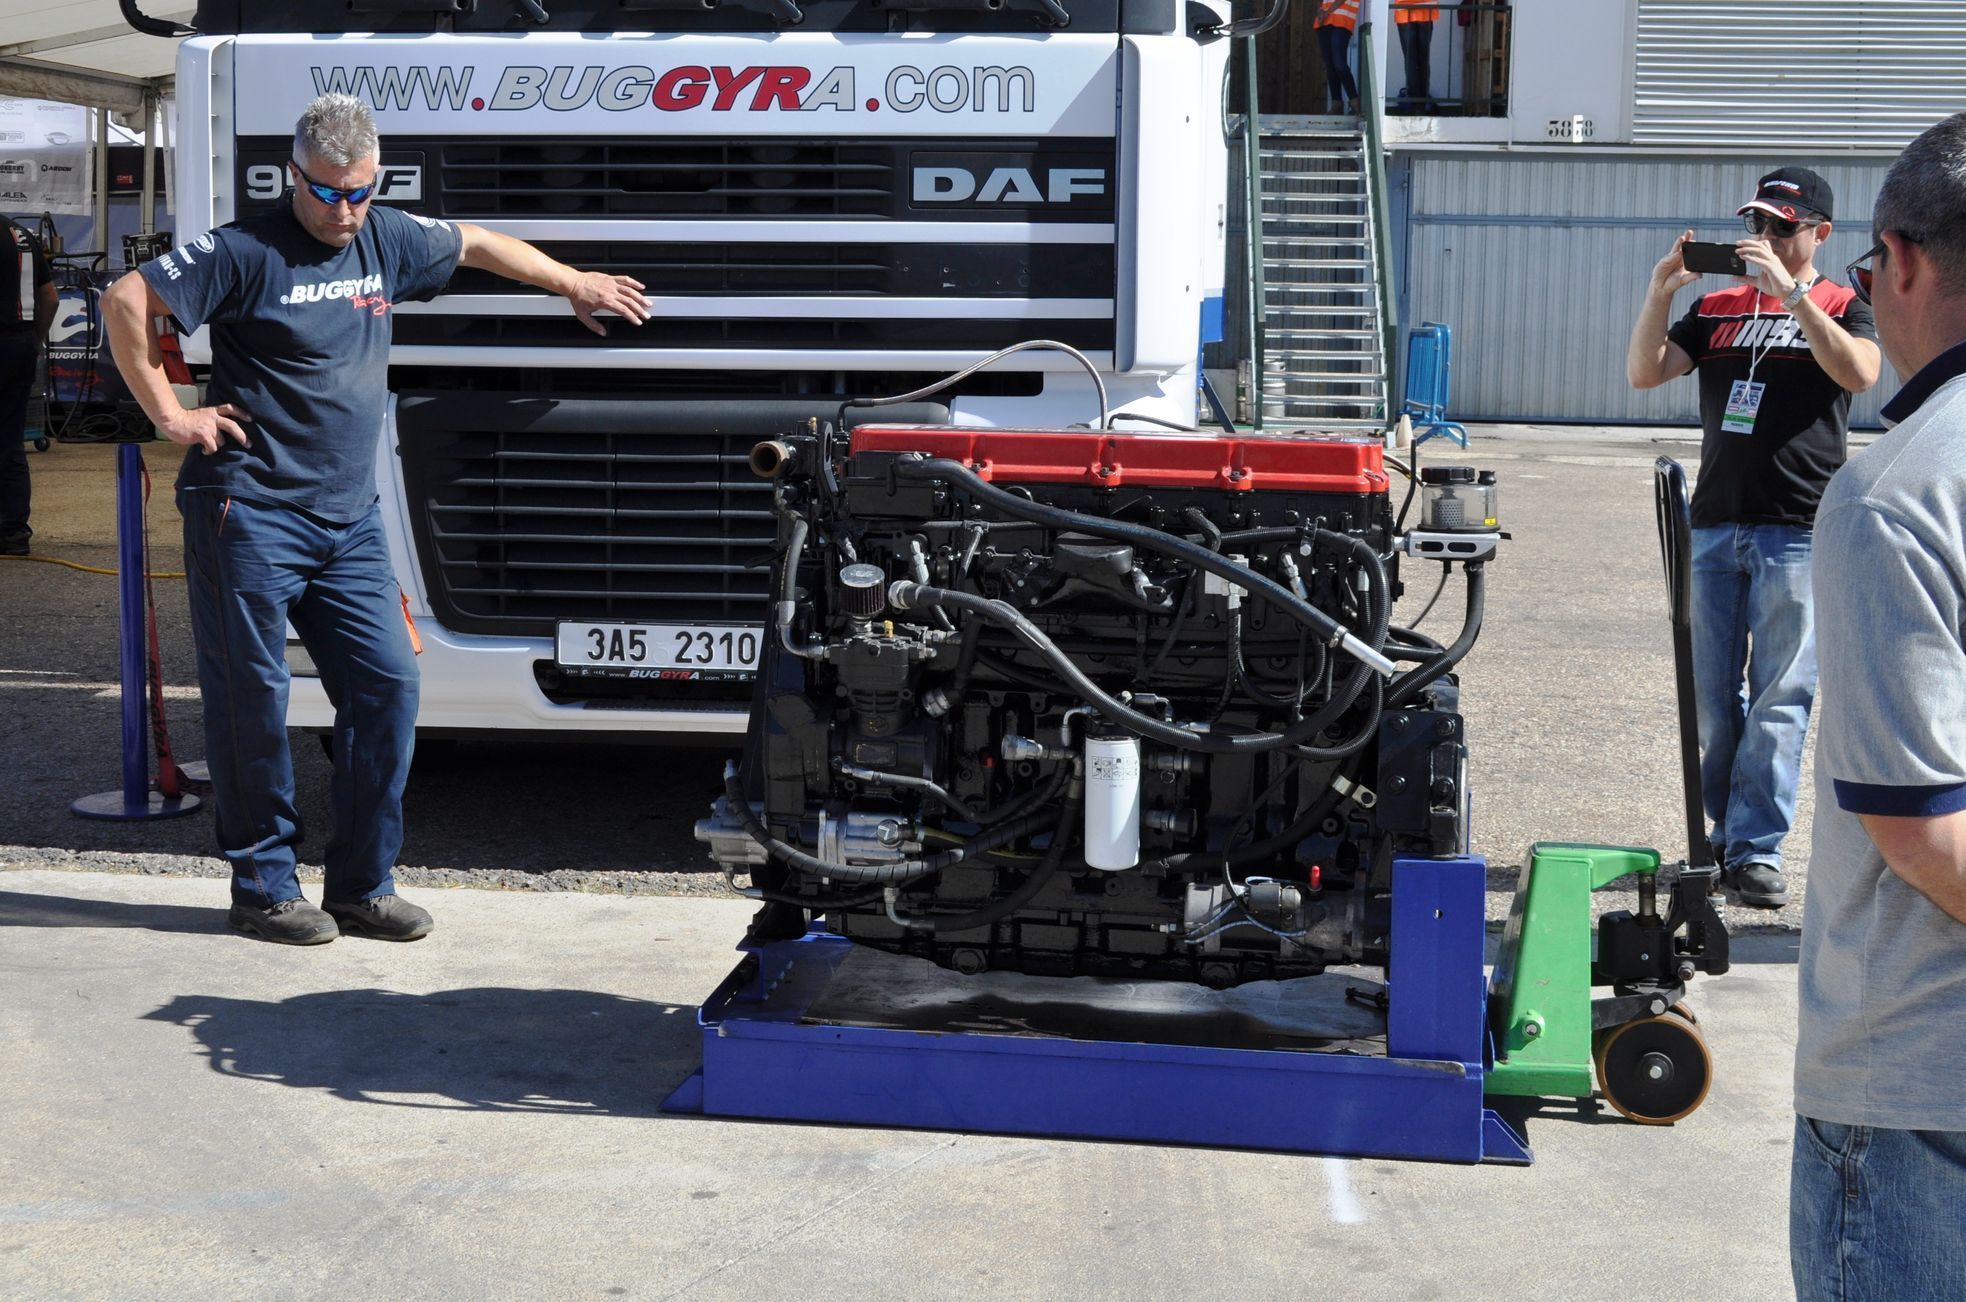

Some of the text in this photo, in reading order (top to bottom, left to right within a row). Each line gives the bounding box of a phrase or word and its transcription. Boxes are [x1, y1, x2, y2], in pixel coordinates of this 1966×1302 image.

[913, 167, 1105, 203] DAF
[587, 628, 757, 666] 3A5 2310
